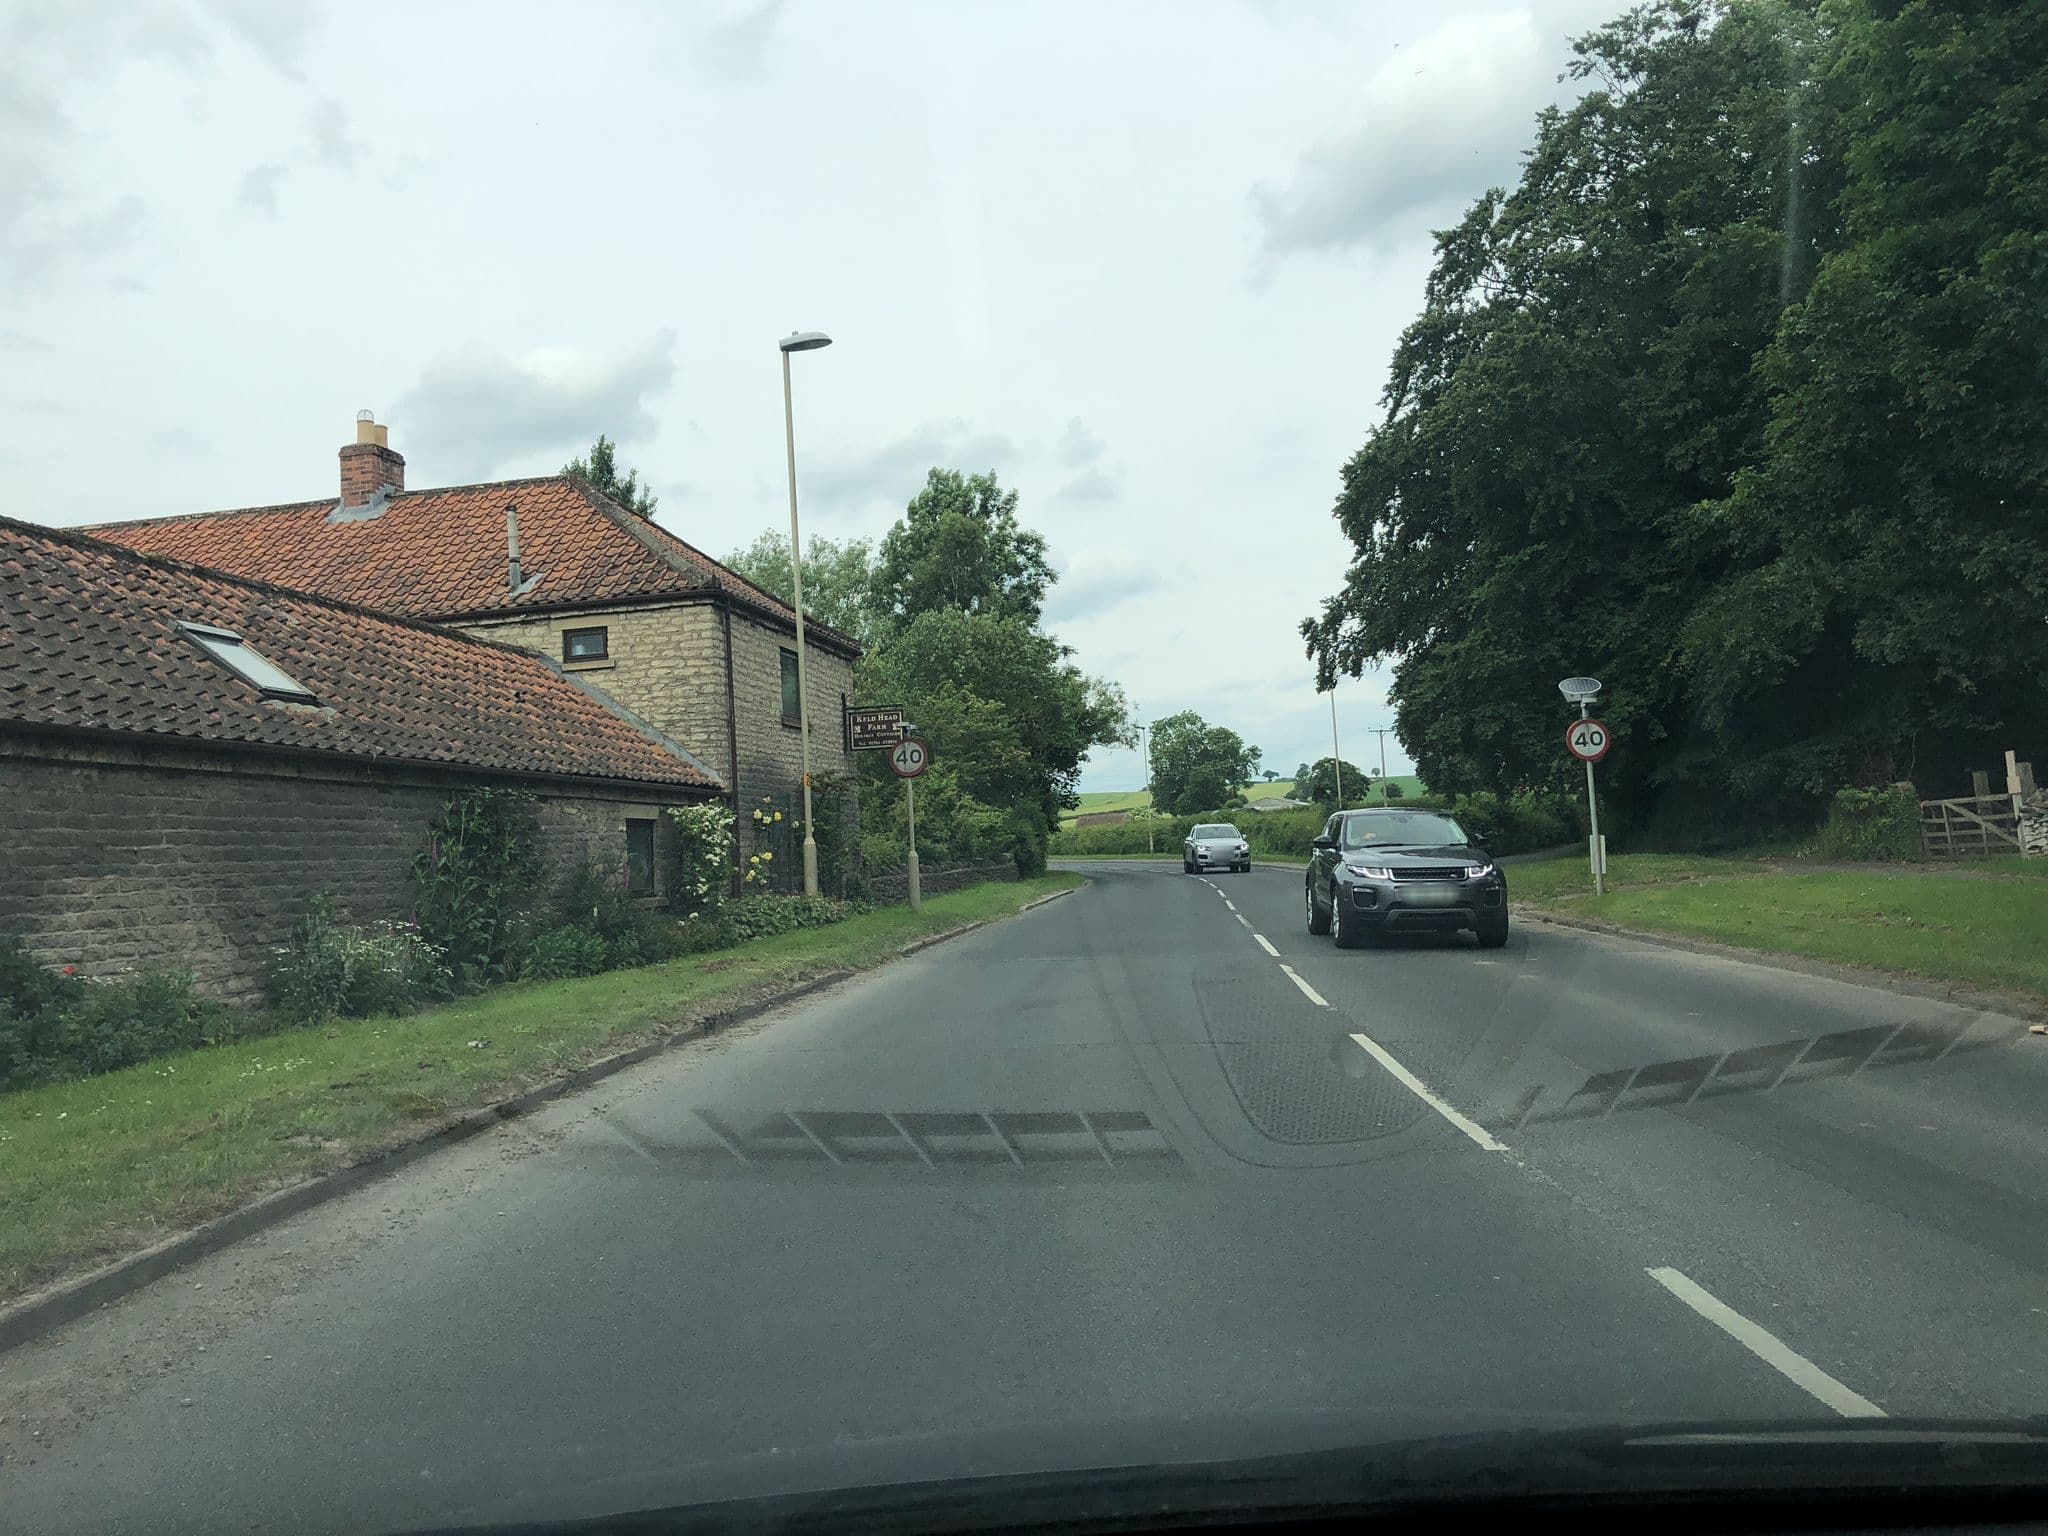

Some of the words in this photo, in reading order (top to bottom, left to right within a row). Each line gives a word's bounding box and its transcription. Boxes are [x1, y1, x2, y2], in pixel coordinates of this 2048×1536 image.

[868, 723, 887, 731] FARM
[1575, 731, 1604, 747] 40
[896, 749, 922, 764] 40
